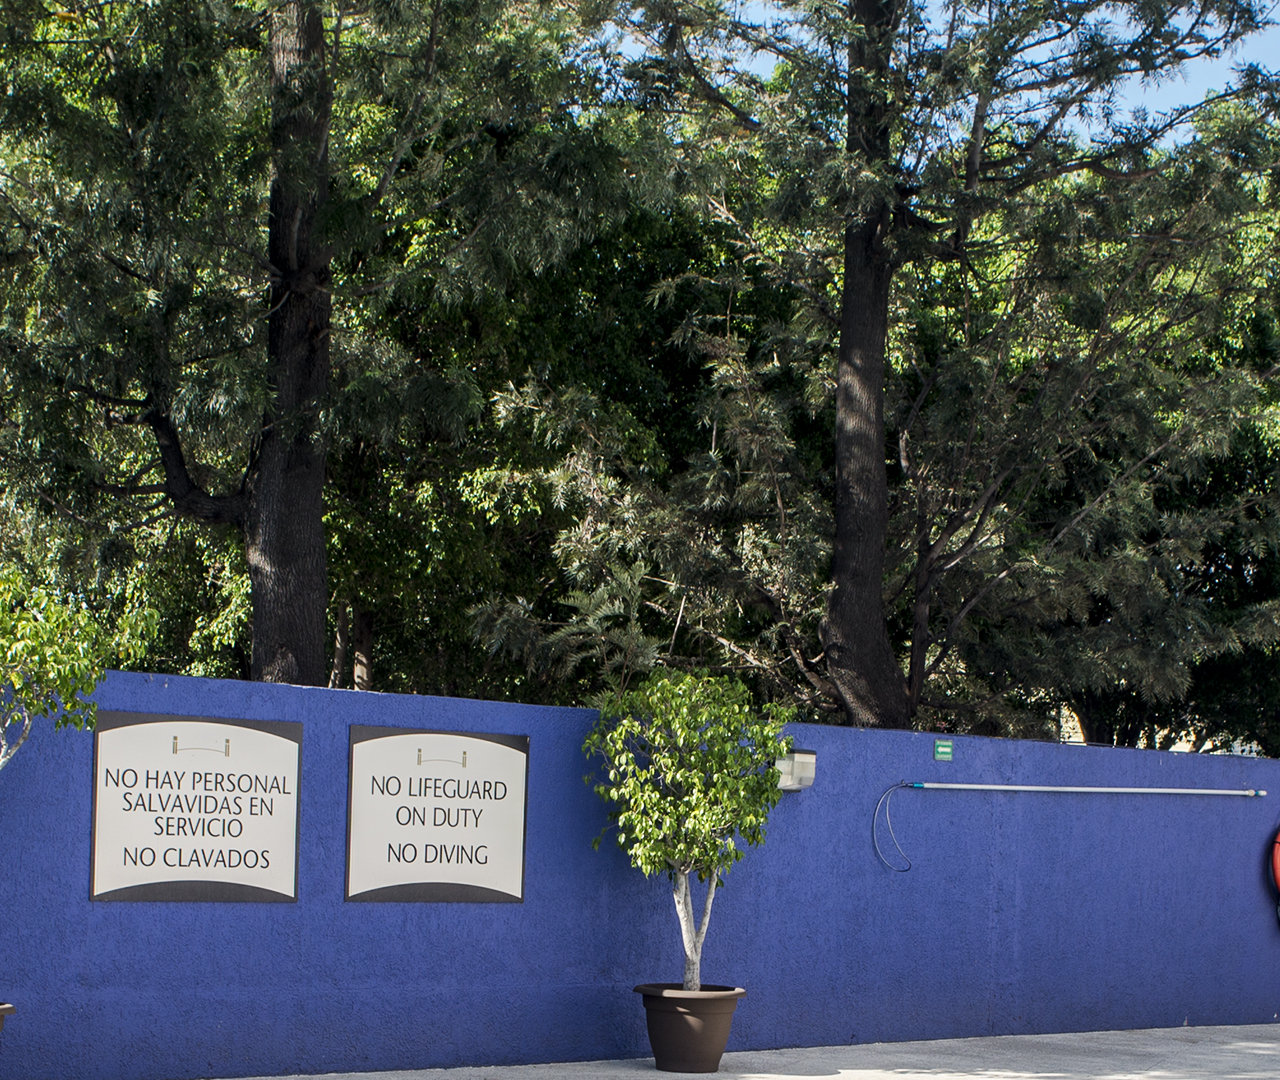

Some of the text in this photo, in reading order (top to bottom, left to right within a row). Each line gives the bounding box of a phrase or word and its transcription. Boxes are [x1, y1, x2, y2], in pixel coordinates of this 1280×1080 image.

[105, 768, 292, 795] NO HAY PERSONAL
[371, 775, 508, 801] NO LIFEGUARD
[122, 791, 274, 817] SALVAVIDAS EN
[153, 816, 243, 838] SERVICIO
[395, 805, 483, 829] ON DUTY
[123, 847, 270, 869] NO CLAVADOS
[387, 842, 488, 865] NO DIVING
